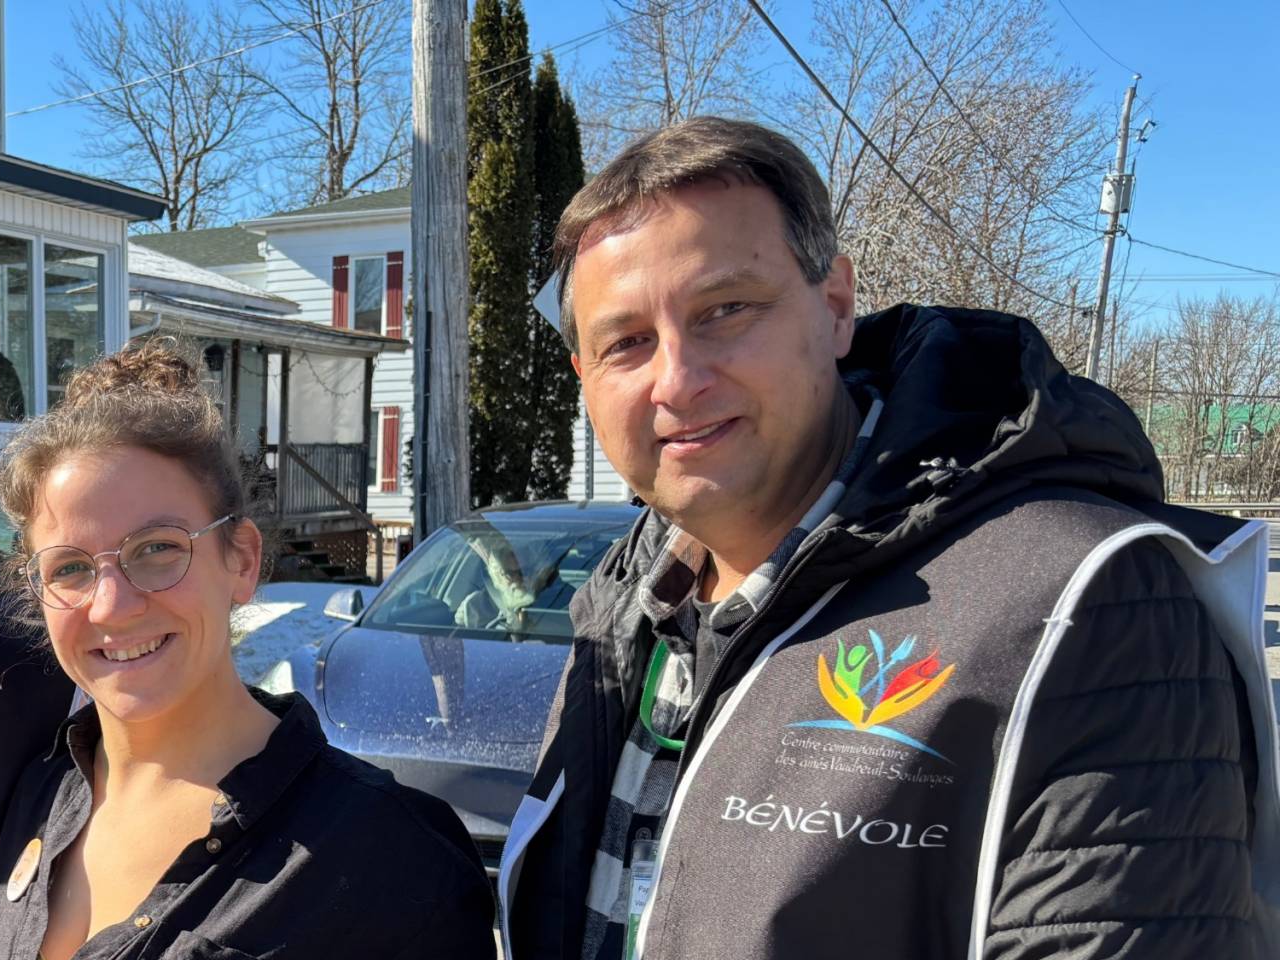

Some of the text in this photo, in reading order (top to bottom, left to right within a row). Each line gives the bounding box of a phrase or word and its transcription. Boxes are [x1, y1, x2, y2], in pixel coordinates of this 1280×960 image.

[775, 750, 796, 767] des
[781, 731, 910, 761] Centre communautaire
[721, 794, 949, 848] BÉNÉVOLE
